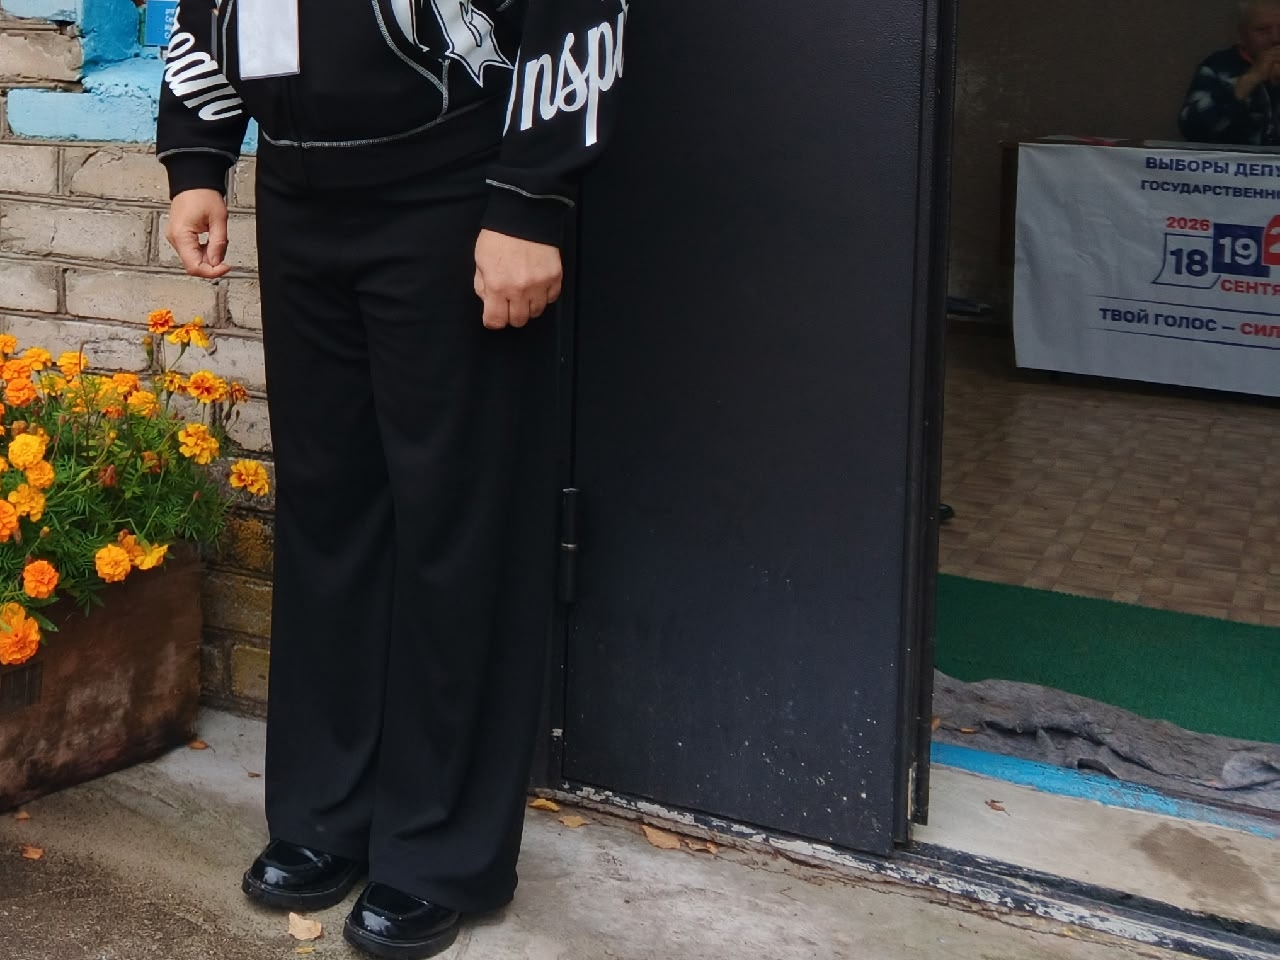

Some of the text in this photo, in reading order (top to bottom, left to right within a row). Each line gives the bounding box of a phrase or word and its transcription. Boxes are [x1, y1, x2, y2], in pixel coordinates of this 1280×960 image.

[1145, 156, 1229, 175] ВЫБОРЫ
[1166, 216, 1210, 232] 2026
[1169, 247, 1209, 277] 18
[1219, 237, 1258, 265] 19
[1098, 307, 1149, 324] ТВОЙ
[1154, 314, 1217, 332] ГОЛОС
